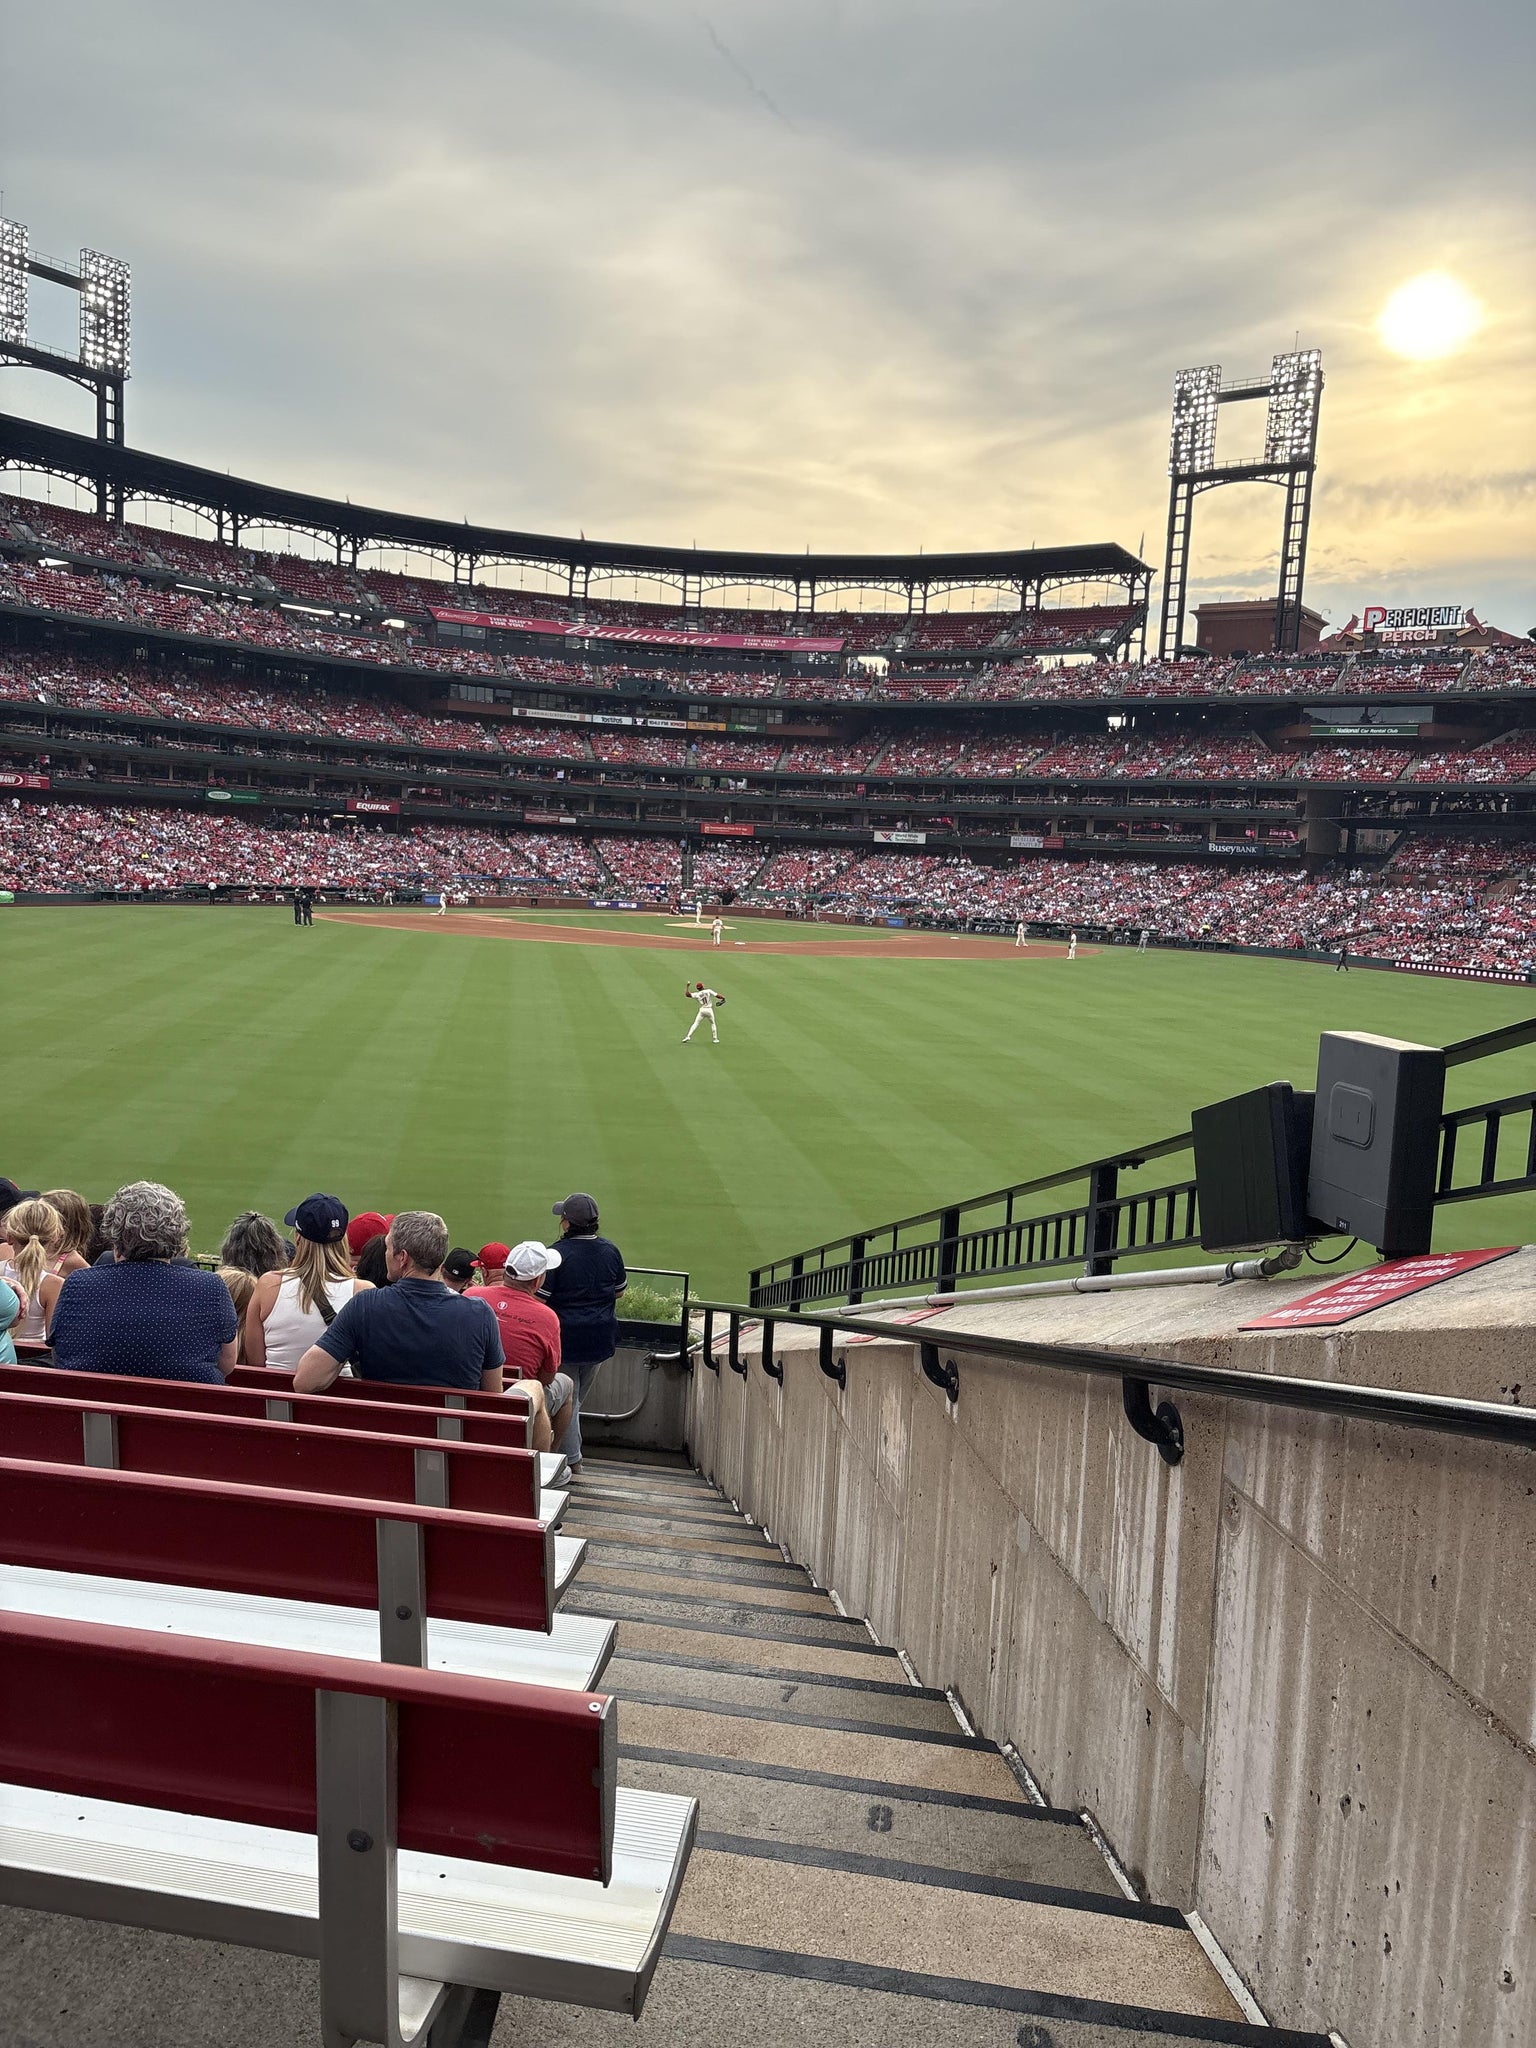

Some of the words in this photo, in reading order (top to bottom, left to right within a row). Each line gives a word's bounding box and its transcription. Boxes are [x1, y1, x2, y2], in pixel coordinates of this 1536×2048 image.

[1363, 605, 1461, 632] PERFICIENT
[559, 622, 719, 646] Budweiser
[1382, 630, 1437, 642] PERCH
[356, 802, 390, 811] EQUIFAX
[331, 1219, 339, 1227] 99
[780, 1685, 799, 1702] 7
[866, 1804, 893, 1833] 8
